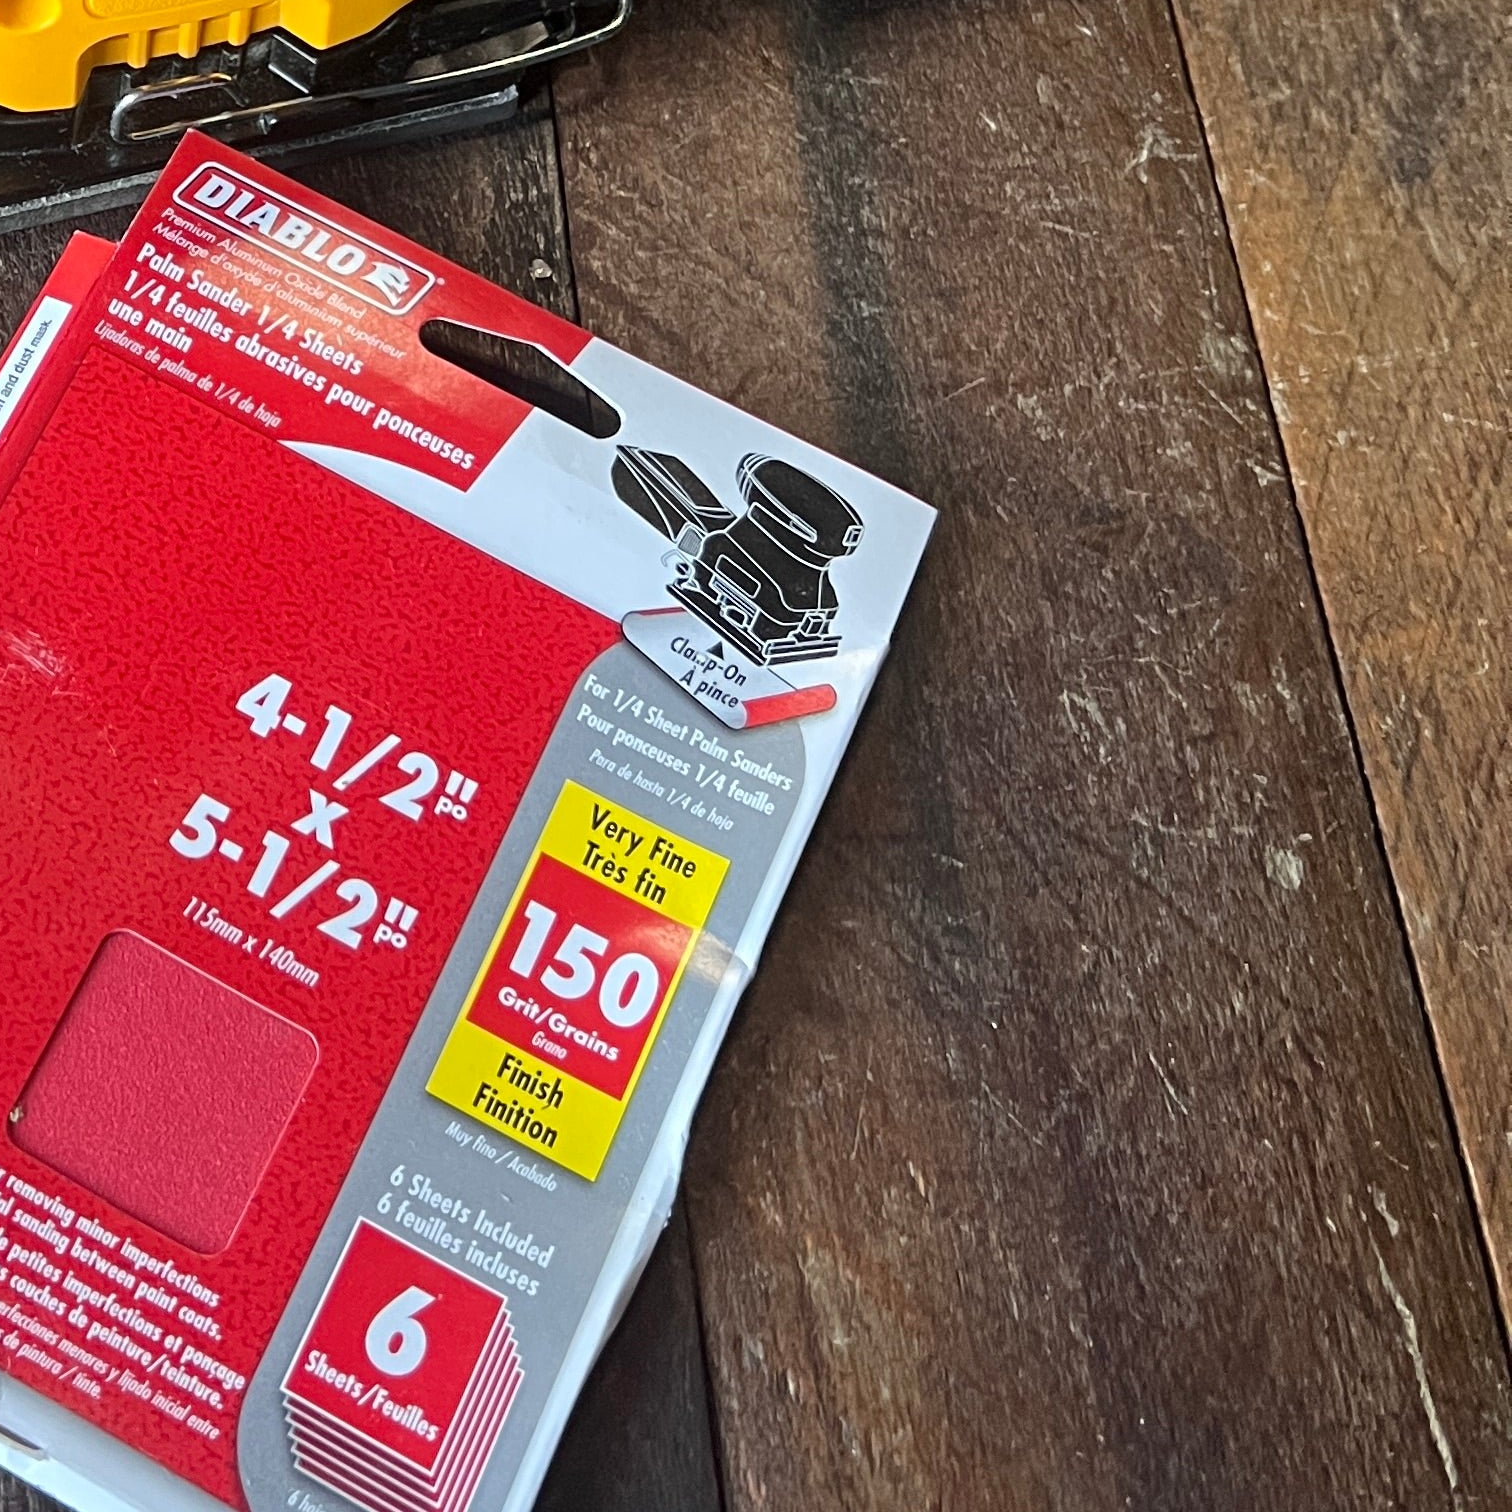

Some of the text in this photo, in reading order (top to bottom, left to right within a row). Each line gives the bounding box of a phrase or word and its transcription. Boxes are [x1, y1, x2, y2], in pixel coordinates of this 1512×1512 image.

[193, 173, 367, 276] DIABLO
[108, 298, 192, 352] une main
[136, 242, 363, 374] Palm Sander 1/4 Sheets
[0, 374, 19, 397] and
[14, 347, 34, 373] dust
[30, 319, 52, 347] mask.
[124, 270, 474, 469] 1/4 feuilles abrasives pour ponceuses
[584, 673, 792, 790] For 1/4 Sheet Palm Sanders
[693, 680, 738, 708] pince
[576, 703, 774, 815] Pour ponceuses 1/4 feuille
[434, 795, 467, 820] po
[591, 803, 696, 878] Very Fine
[582, 840, 666, 904] Très fin
[183, 896, 319, 987] 115mm x 140mm
[373, 923, 407, 948] po
[508, 901, 660, 1028] 150
[498, 986, 618, 1060] Grit/Grains
[472, 1082, 557, 1148] Finition
[496, 1052, 563, 1108] Finish
[6, 1175, 75, 1227] removing
[75, 1216, 120, 1248] minor
[120, 1237, 219, 1307] imperfections
[377, 1192, 539, 1295] 6 feuilles incluses
[390, 1164, 554, 1268] 6 Sheets Included
[6, 1243, 62, 1282] petites
[62, 1270, 162, 1341] imperfections
[163, 1334, 182, 1352] et
[180, 1345, 245, 1390] ponçage
[12, 1209, 70, 1254] sanding
[70, 1236, 135, 1289] between
[133, 1281, 177, 1312] paint
[178, 1306, 221, 1340] coats.
[366, 1285, 437, 1376] 6
[304, 1350, 438, 1441] Sheets/Feuilles
